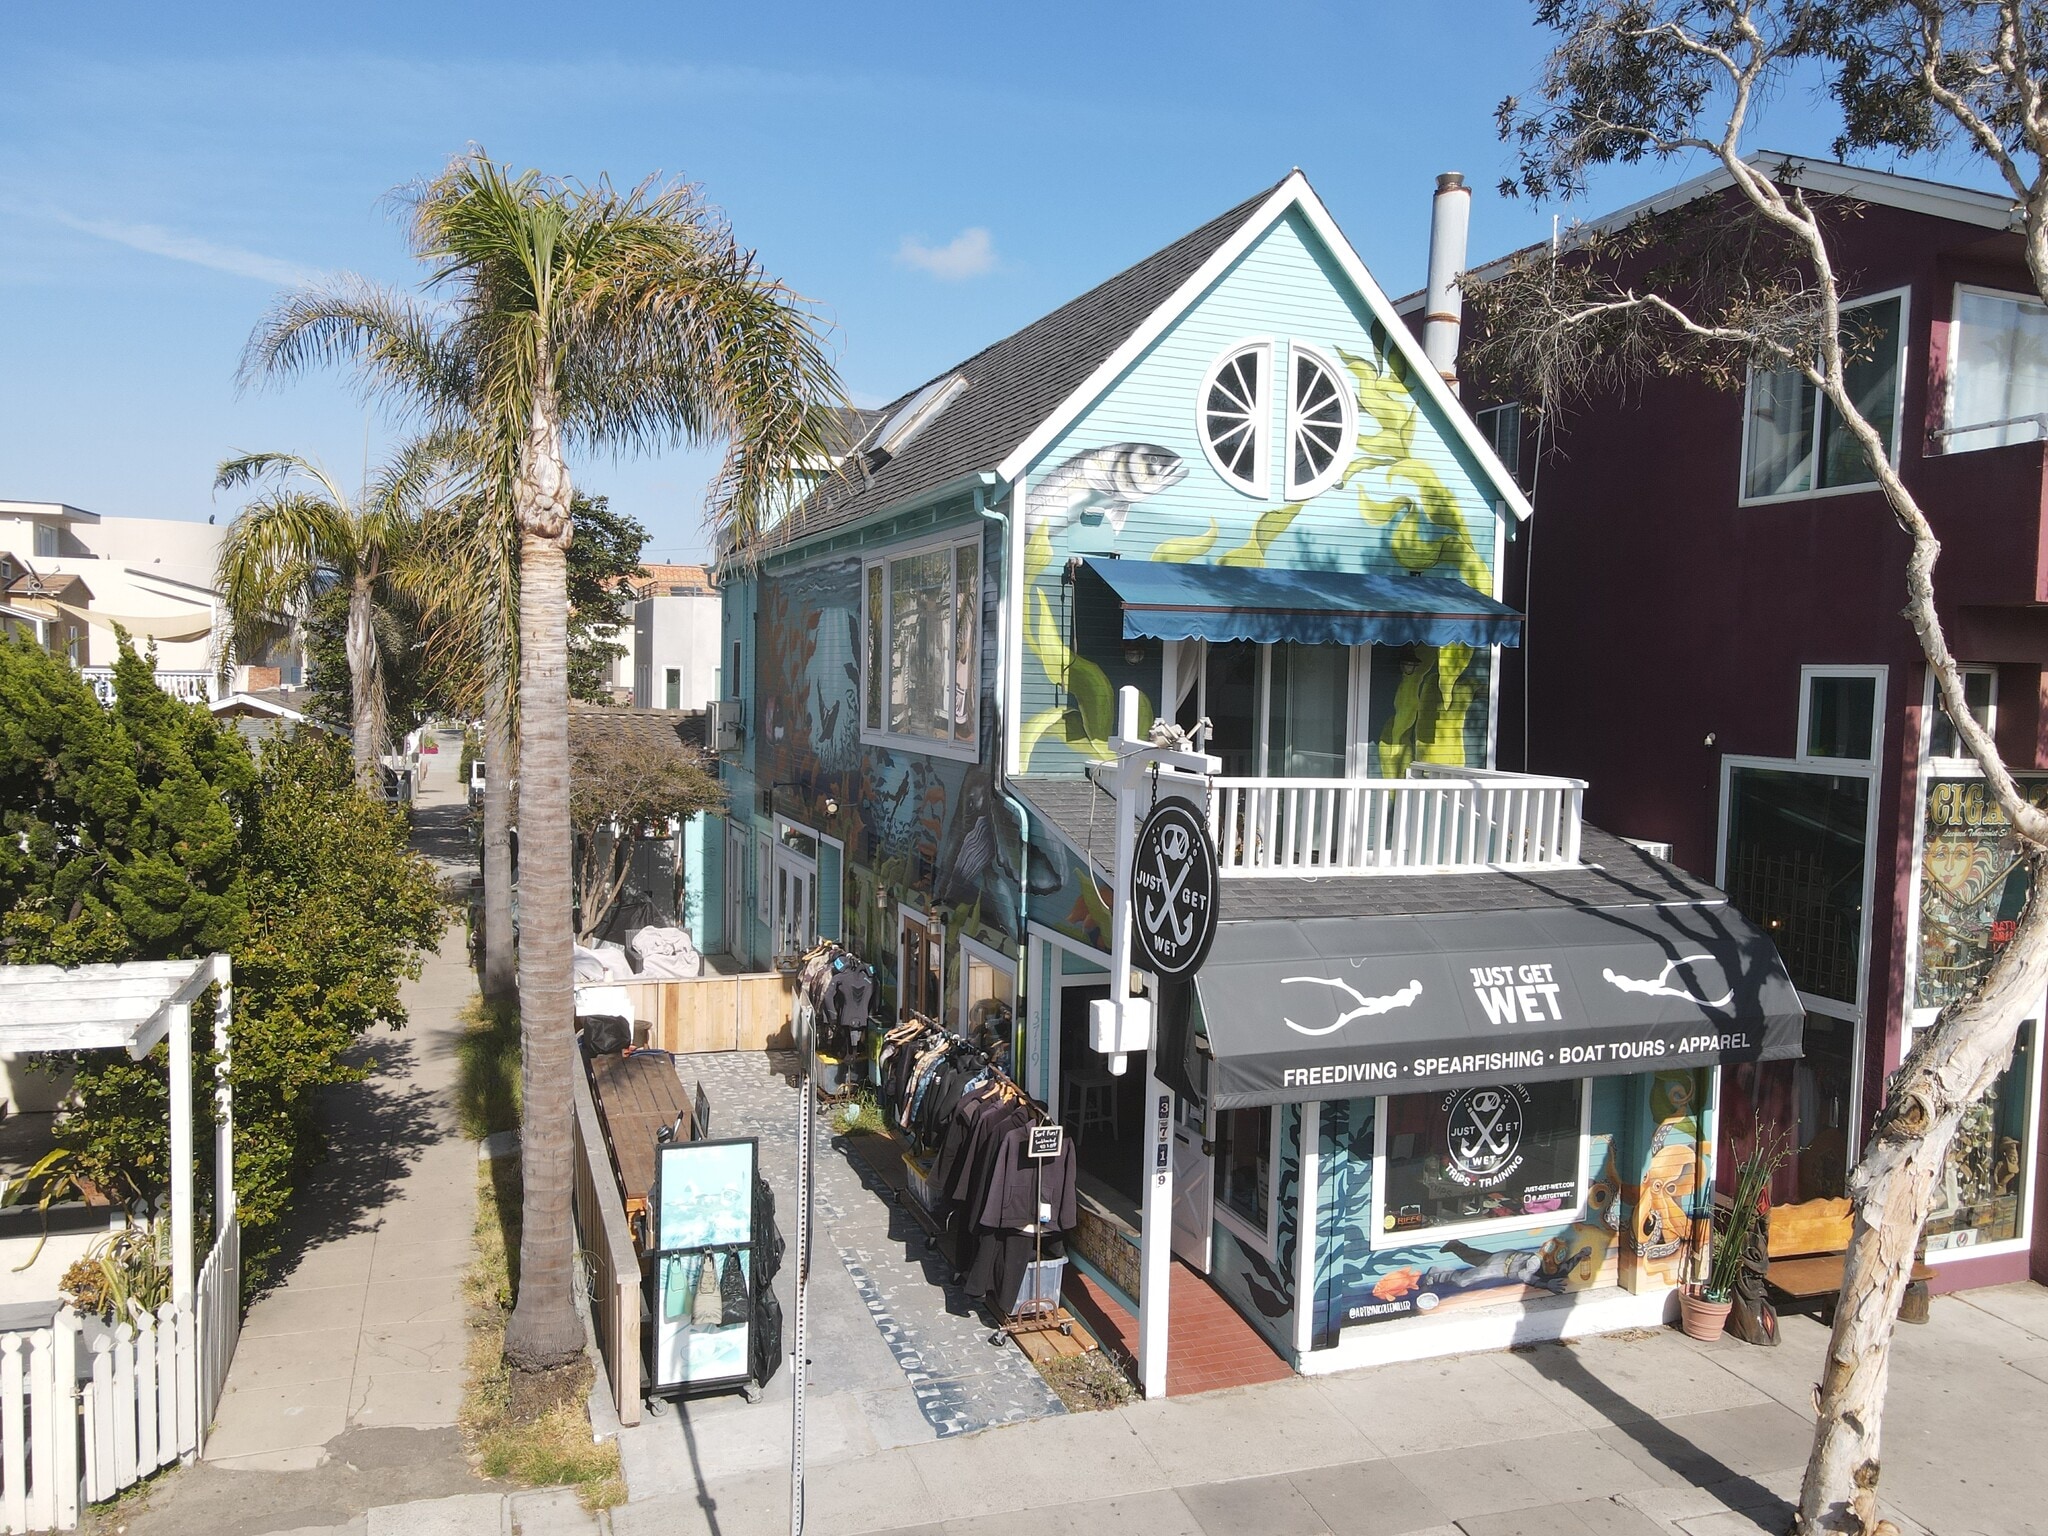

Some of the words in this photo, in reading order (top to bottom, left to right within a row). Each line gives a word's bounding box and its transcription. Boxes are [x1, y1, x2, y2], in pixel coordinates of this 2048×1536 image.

[1136, 870, 1162, 892] JUST
[1182, 888, 1207, 910] GET
[1154, 934, 1178, 957] WET
[1469, 966, 1514, 987] JUST
[1518, 963, 1553, 984] GET
[1474, 983, 1562, 1025] WET
[1283, 1061, 1397, 1087] FREEDIVING
[1413, 1049, 1544, 1077] SPEARFISHING
[1559, 1044, 1605, 1064] BOAT
[1608, 1038, 1665, 1060] TOURS
[1678, 1032, 1751, 1054] APPAREL
[1451, 1126, 1475, 1137] JUST
[1496, 1121, 1519, 1132] GET
[1445, 1162, 1471, 1187] TRIPS
[1479, 1155, 1524, 1188] TRAINING
[1472, 1155, 1496, 1166] WET
